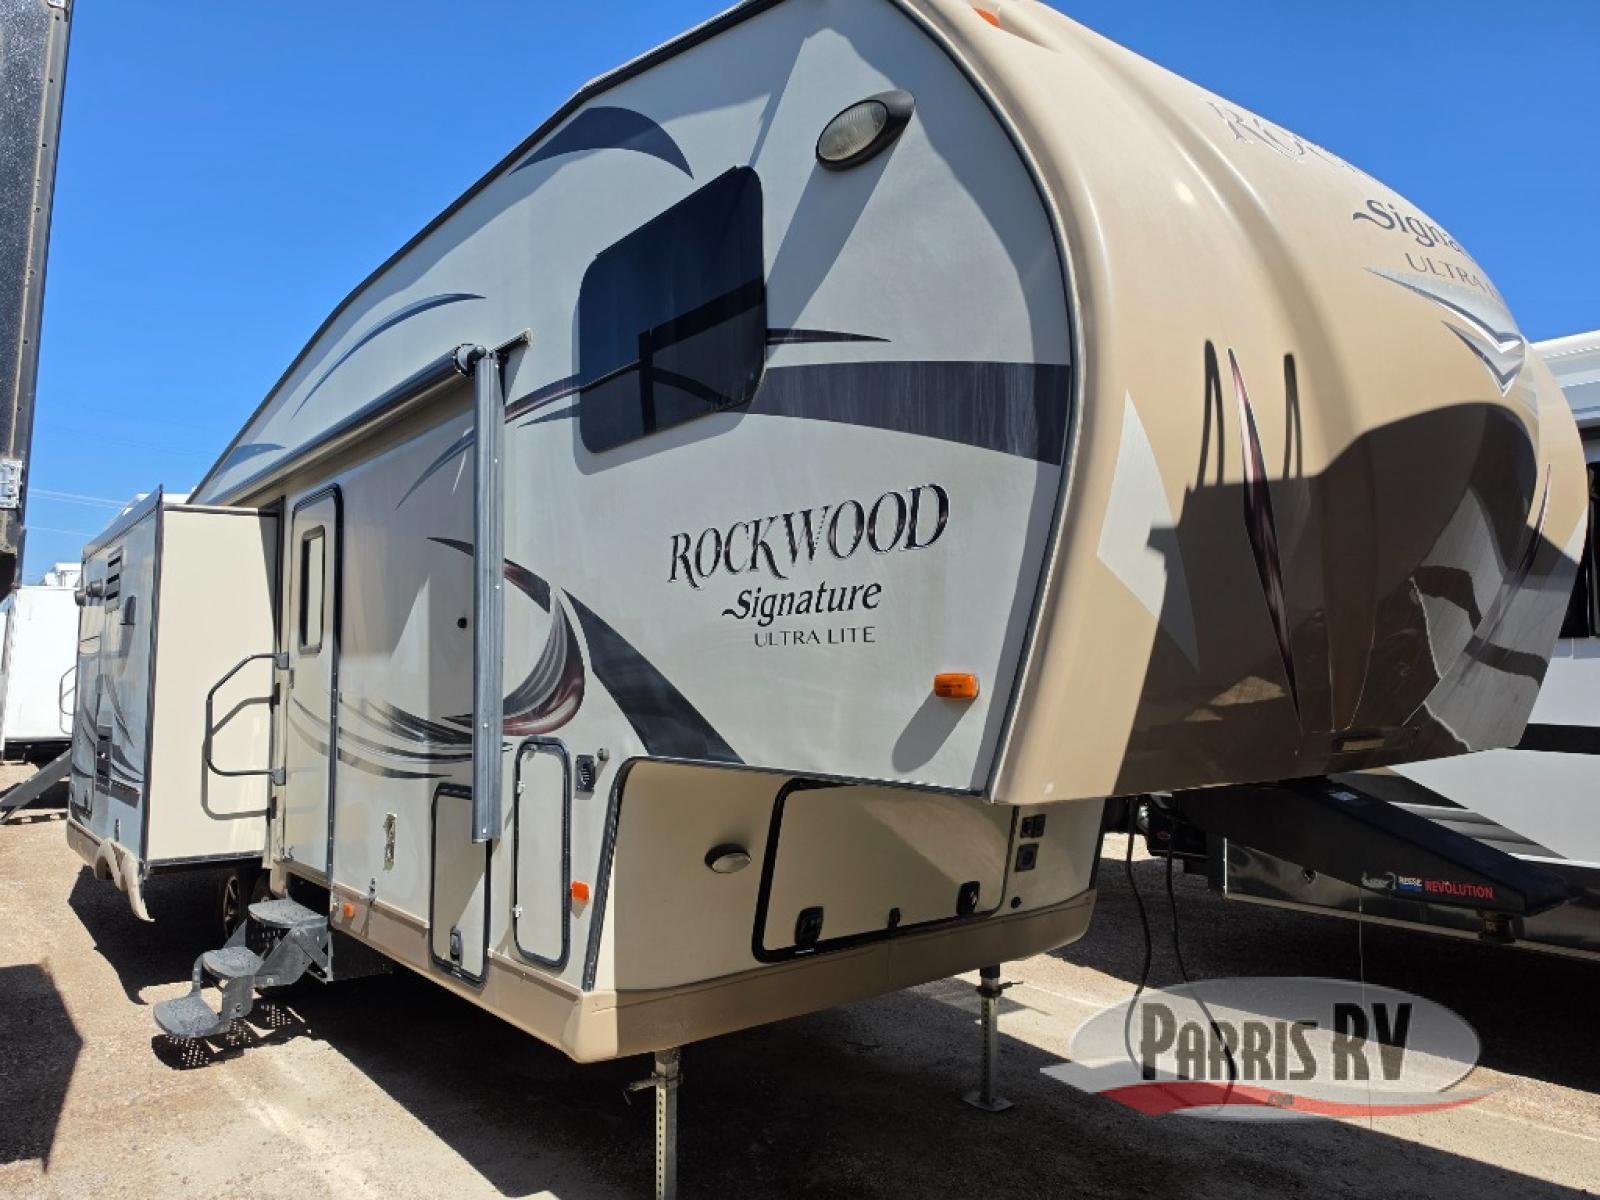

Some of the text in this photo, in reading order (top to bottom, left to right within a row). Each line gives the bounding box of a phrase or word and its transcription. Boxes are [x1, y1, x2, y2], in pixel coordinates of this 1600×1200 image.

[667, 483, 949, 590] ROCKWOOD
[722, 581, 882, 627] Signature
[754, 626, 876, 647] ULTRA LITE
[1424, 880, 1494, 899] REVOLUTION
